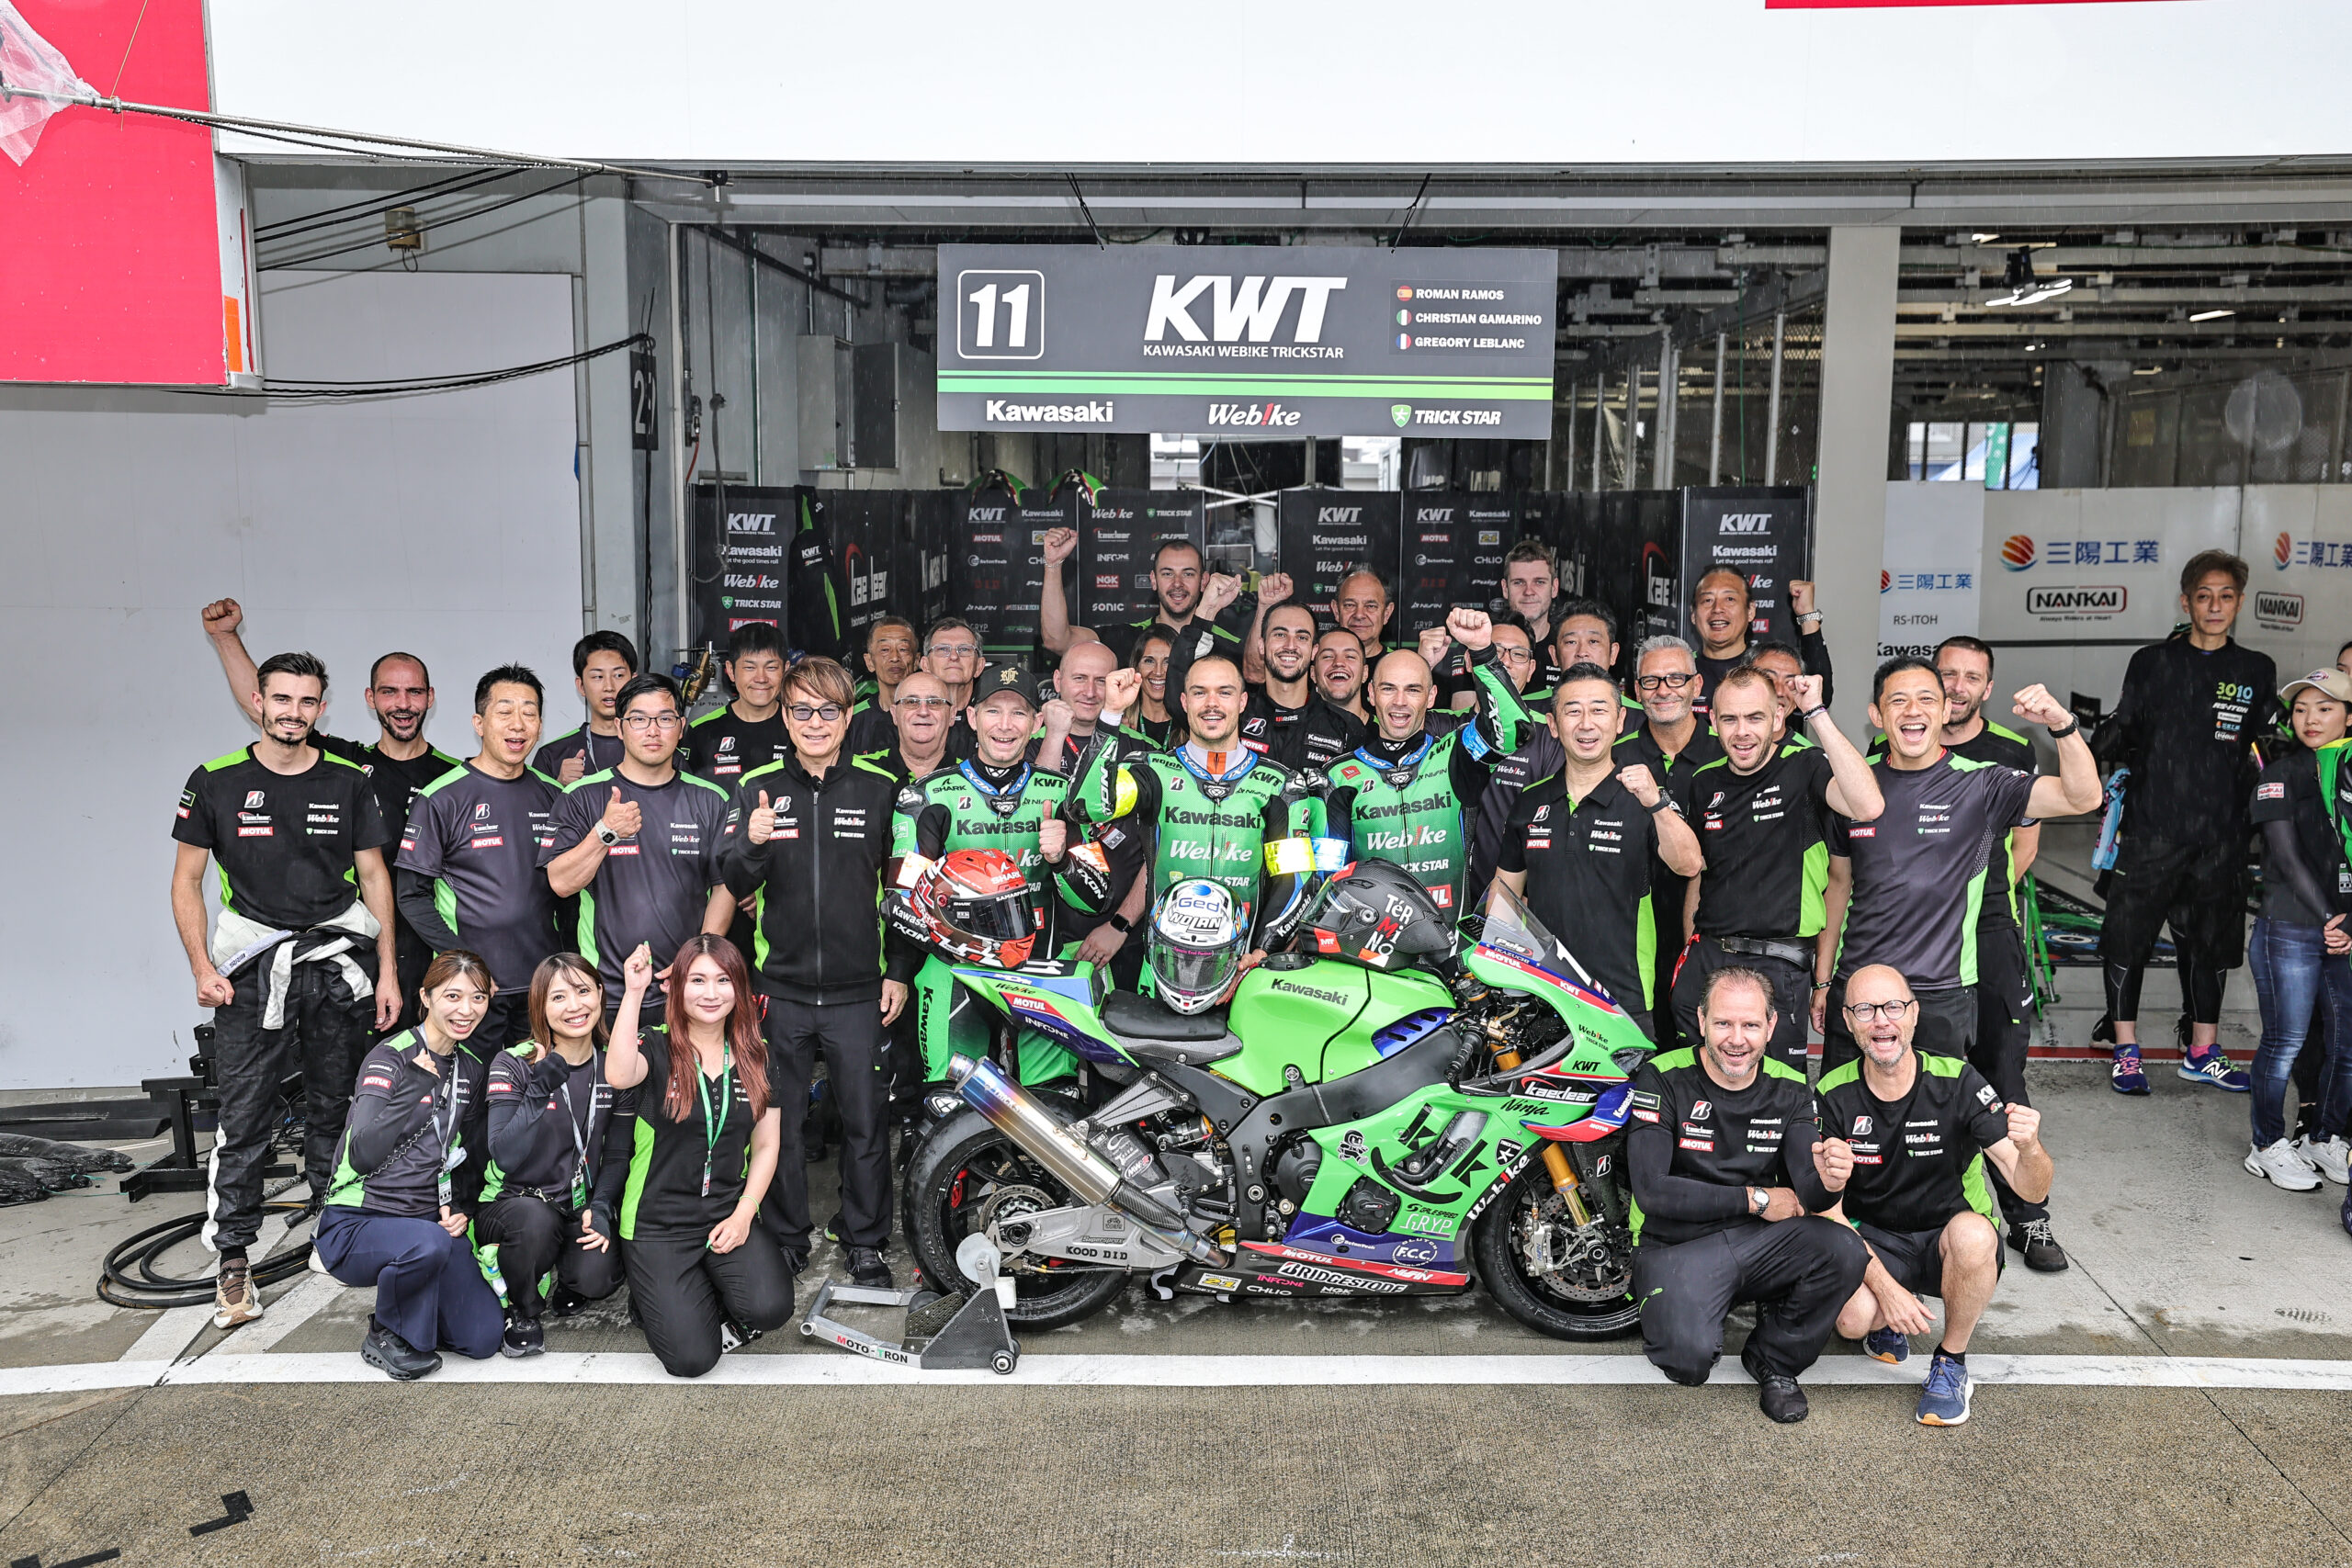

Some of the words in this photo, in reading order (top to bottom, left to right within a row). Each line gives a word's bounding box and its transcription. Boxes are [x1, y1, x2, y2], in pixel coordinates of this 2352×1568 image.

[1416, 288, 1458, 299] ROMAN
[1462, 288, 1504, 300] RAMOS
[969, 283, 1030, 347] 11
[1144, 275, 1348, 344] KWT
[1416, 312, 1476, 324] CHRISTIAN
[1479, 313, 1542, 325] GAMARINO
[1415, 336, 1470, 348] GREGORY
[1473, 337, 1524, 349] LEBLANC
[1143, 344, 1215, 356] KAWASAKI
[1217, 346, 1269, 357] WEB!KE
[1272, 346, 1344, 358] TRICKSTAR
[987, 400, 1113, 423] Kawasaki
[1415, 409, 1459, 425] TRICK
[1462, 410, 1501, 425] STAR
[968, 508, 1006, 520] KWT
[1317, 507, 1363, 522] KWT
[1417, 509, 1453, 521] KWT
[727, 513, 775, 531] KWT
[1719, 513, 1772, 531] KWT
[1312, 535, 1367, 545] Kawasaki
[1713, 546, 1777, 557] Kawasaki
[2046, 540, 2159, 566] 三陽工業
[1096, 576, 1118, 584] NGK
[1897, 572, 1973, 590] 三陽工業
[735, 600, 759, 608] TRICK
[761, 600, 782, 609] STAR
[2036, 592, 2119, 609] NANKAI
[2259, 598, 2300, 618] NANKAI
[1893, 615, 1939, 626] RS-ITOH
[1307, 734, 1342, 748] Kawasaki
[1034, 778, 1066, 790] KWT
[1249, 770, 1283, 786] KWT
[933, 784, 967, 794] SHARK
[1355, 792, 1452, 820] Kawasaki
[1165, 806, 1261, 829] Kawasaki
[1594, 818, 1623, 827] Kawasaki
[240, 828, 271, 836] MOTUL
[957, 817, 1040, 835] Kawasa
[770, 829, 797, 839] MOTUL
[472, 838, 503, 847] MOTUL
[1527, 840, 1550, 848] MOTUL
[610, 846, 638, 854] MOTUL
[1421, 859, 1449, 872] STAR
[990, 871, 1022, 884] SHARK
[1178, 897, 1219, 912] Ged
[892, 905, 927, 929] Kawasa
[1168, 912, 1222, 934] NOLAN
[892, 921, 931, 942] IXON
[1364, 931, 1394, 956] NO
[1485, 950, 1521, 969] MOTUL
[1494, 947, 1531, 964] IKAZUCHI
[1271, 978, 1349, 1006] Kawasaki
[1560, 980, 1581, 996] KWT
[1013, 997, 1046, 1010] MOTUL
[922, 987, 934, 1082] Kawasaki
[368, 1063, 393, 1072] Kawasaki
[1572, 1060, 1601, 1072] KWT
[363, 1077, 391, 1088] MOTUL
[489, 1083, 511, 1091] MOTUL
[1524, 1081, 1599, 1102] kaedear
[1500, 1098, 1551, 1117] Ninja
[1612, 1088, 1635, 1118] Kawasaki
[1589, 1123, 1609, 1132] MOTUL
[1680, 1138, 1713, 1149] MOTUL
[1402, 1237, 1438, 1250] CLUTCH
[1066, 1246, 1098, 1258] KOOD
[1282, 1248, 1333, 1264] MOTUL
[1396, 1247, 1430, 1259] F.C.C.
[1278, 1261, 1408, 1293] BRIDGESTONE
[1321, 1286, 1353, 1294] NGK
